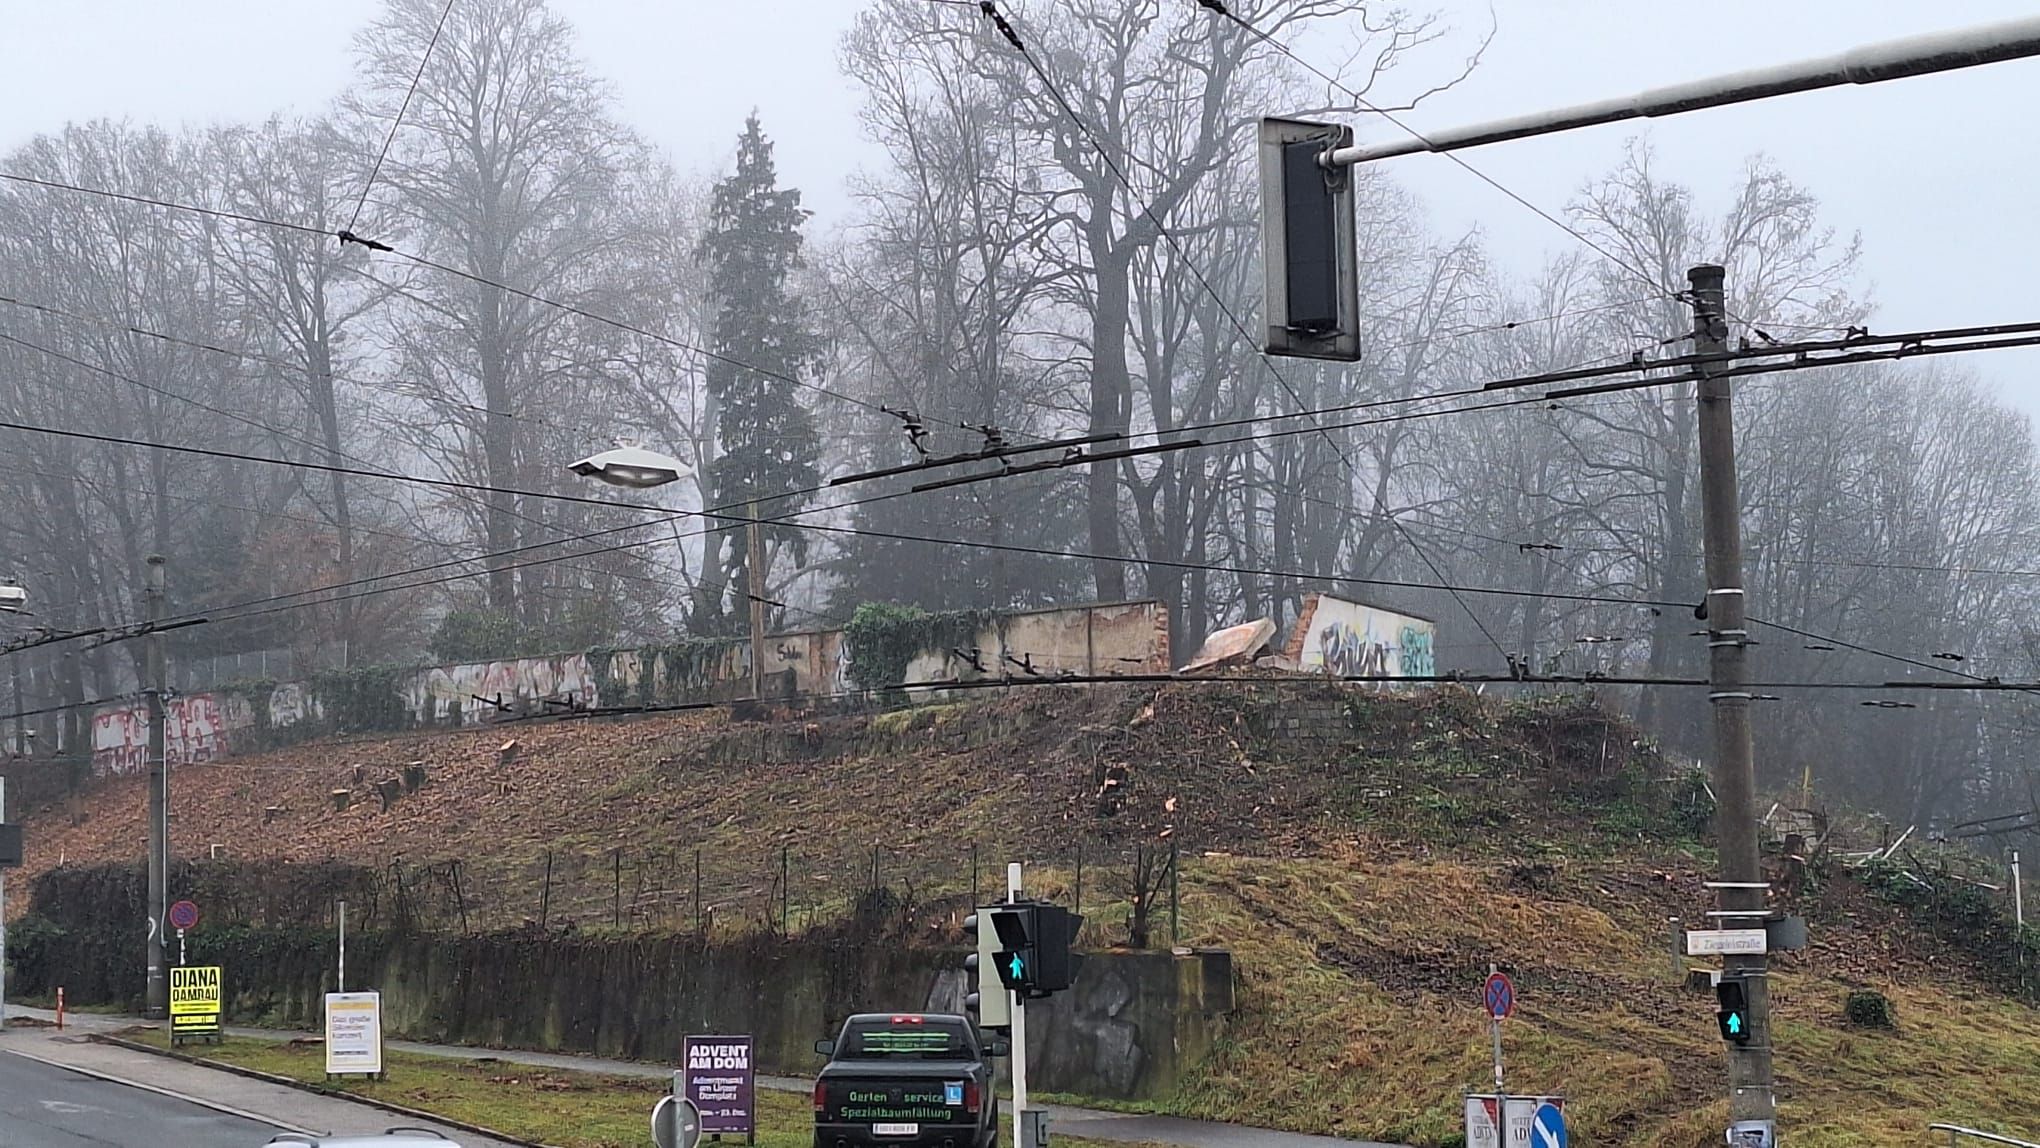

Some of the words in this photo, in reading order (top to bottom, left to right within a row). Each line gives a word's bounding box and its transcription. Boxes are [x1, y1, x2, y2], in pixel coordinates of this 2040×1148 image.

[173, 969, 218, 988] DIANA
[173, 988, 218, 1001] DAMRAU
[690, 1045, 748, 1057] ADVENT
[689, 1058, 711, 1069] AM
[714, 1058, 748, 1069] DOM
[850, 1091, 887, 1102] Garten
[904, 1092, 944, 1103] service
[950, 1086, 958, 1099] L
[840, 1106, 952, 1119] Spezialbaumfällung
